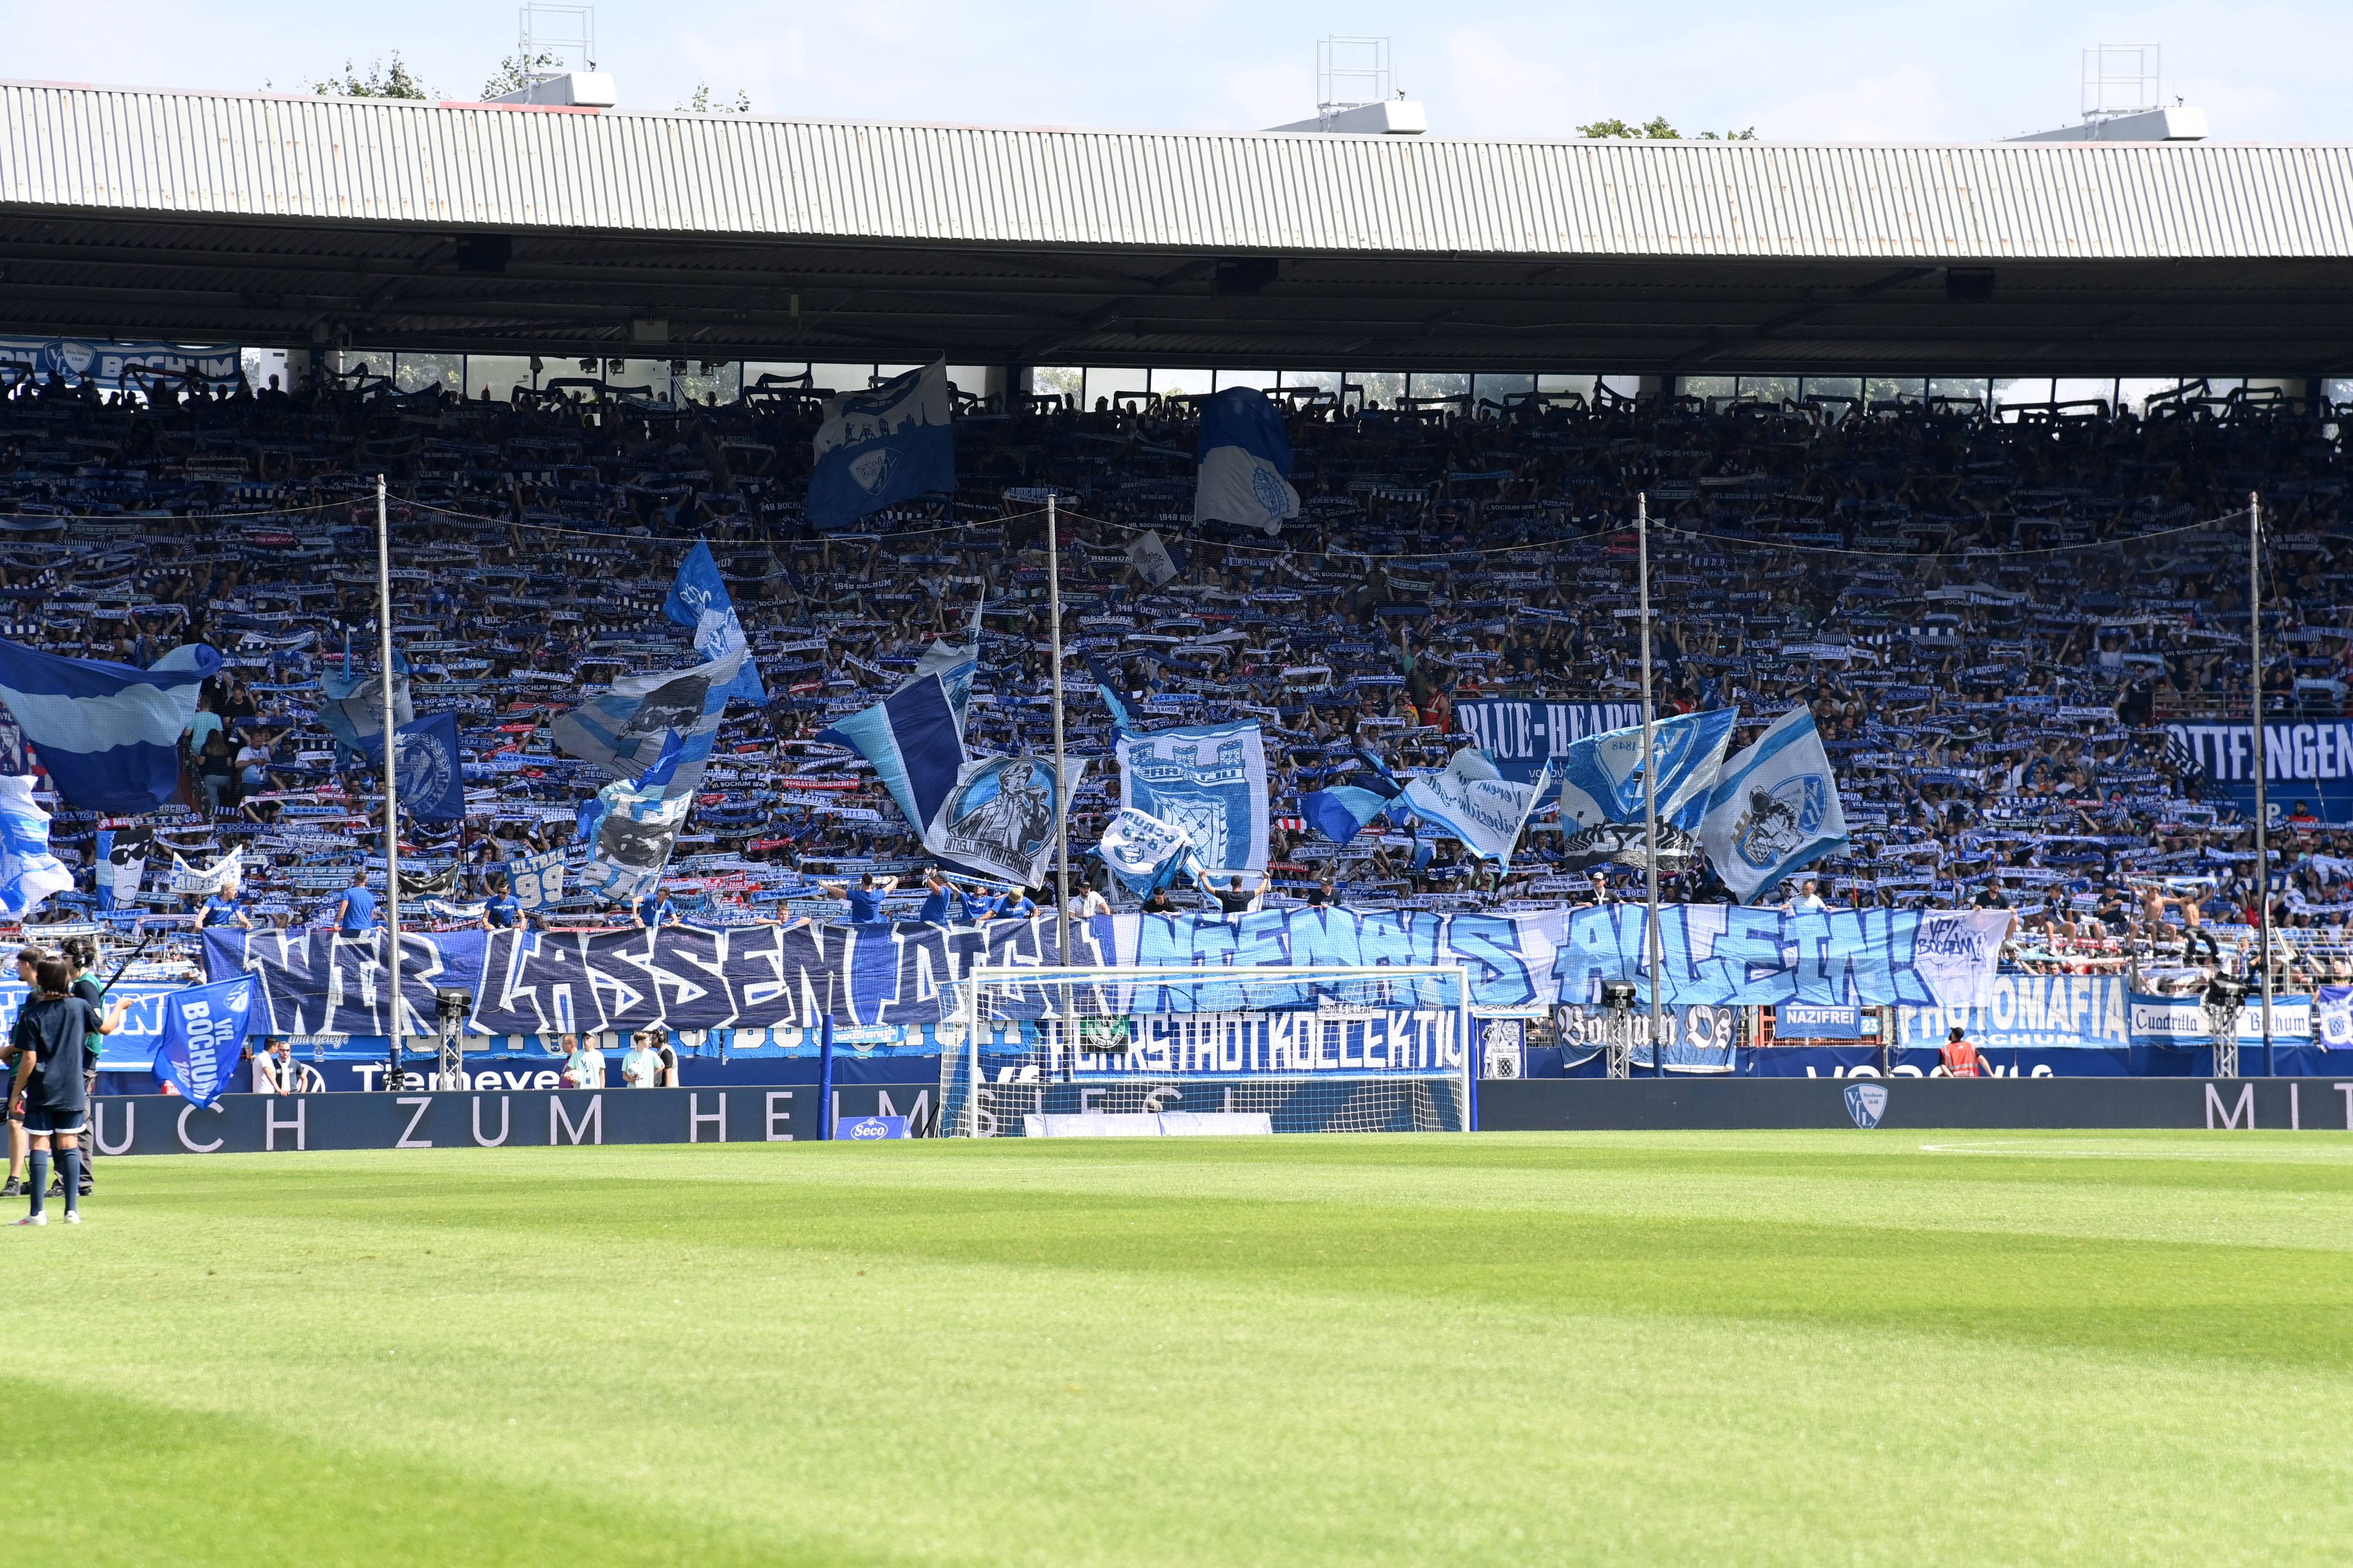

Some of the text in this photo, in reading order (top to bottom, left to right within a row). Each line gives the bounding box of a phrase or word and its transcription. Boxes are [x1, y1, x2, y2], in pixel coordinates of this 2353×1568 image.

[101, 355, 234, 378] BOCHUM
[856, 579, 892, 589] BOCHUM
[1702, 656, 1730, 664] BOCHUM
[2120, 773, 2156, 782] BOCHUM
[514, 863, 563, 909] 99
[1786, 1011, 1855, 1025] NAZIFREI
[1861, 1019, 1879, 1032] 23
[2135, 1007, 2199, 1034] Cuadrilla
[215, 1017, 235, 1045] VfL
[182, 1000, 220, 1100] BOCHUM
[95, 1097, 305, 1155] UCH
[395, 1095, 602, 1148] ZUM
[855, 1125, 886, 1136] Seco
